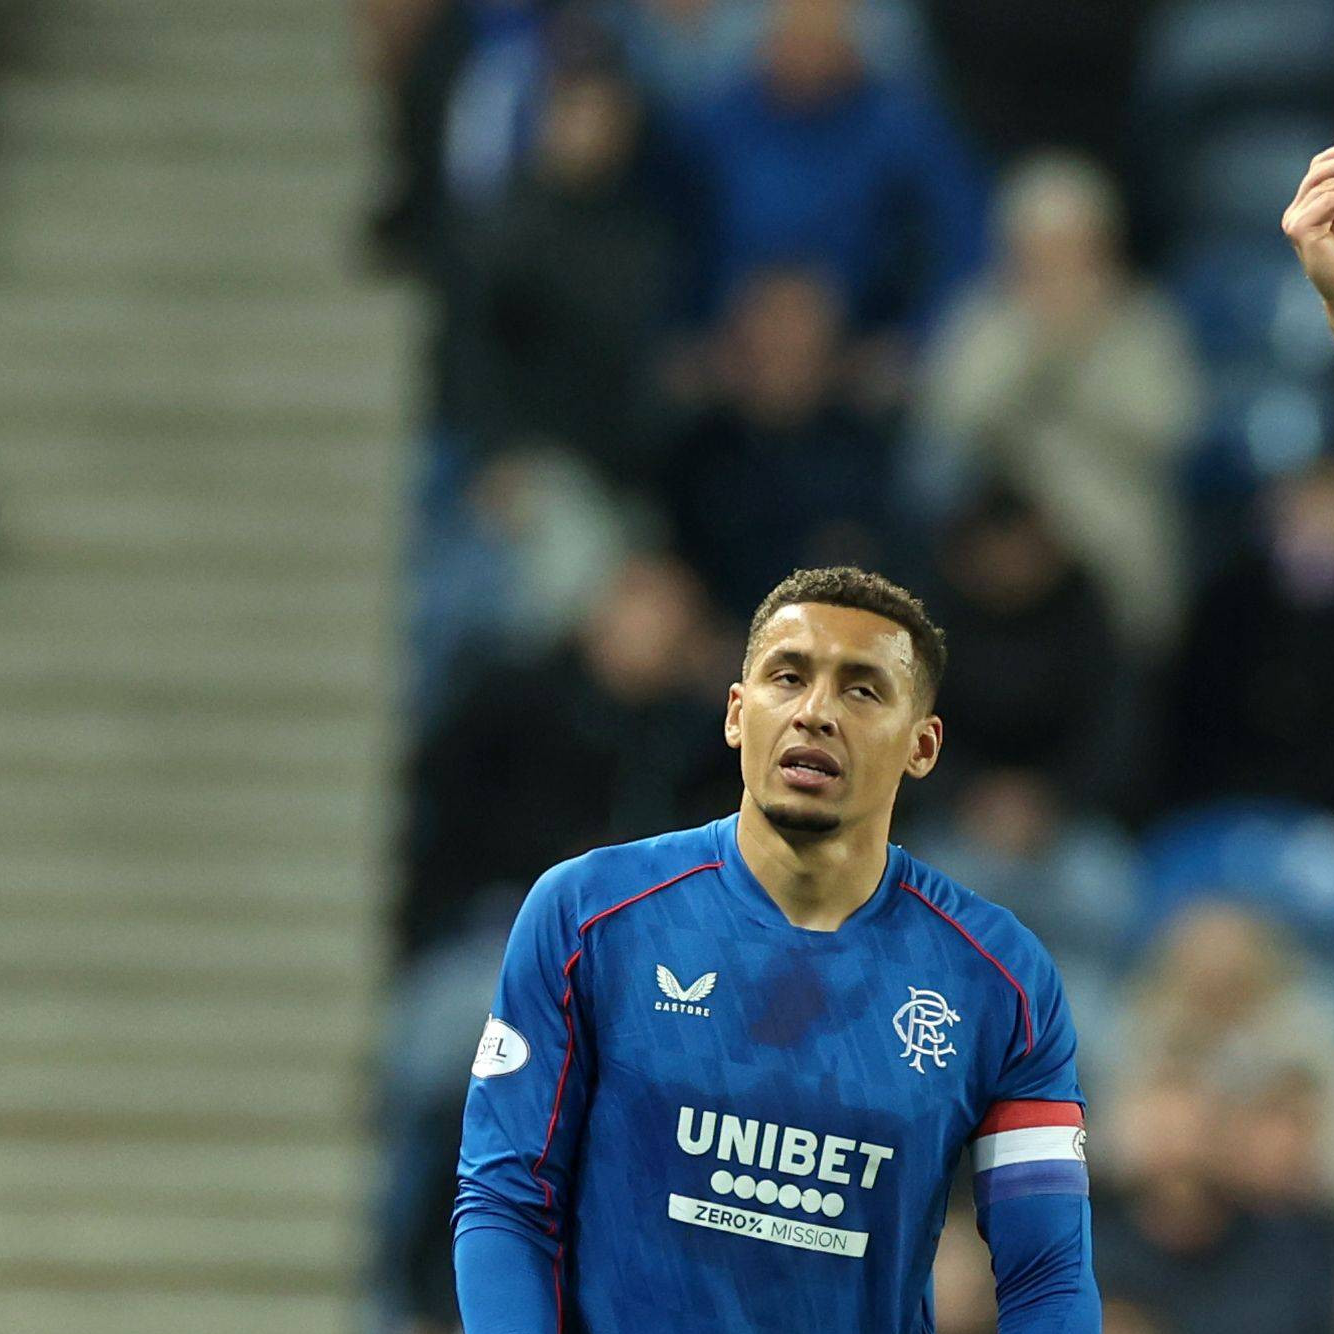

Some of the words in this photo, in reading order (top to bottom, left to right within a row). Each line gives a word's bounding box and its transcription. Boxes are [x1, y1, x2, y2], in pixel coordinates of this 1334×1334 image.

[654, 1001, 711, 1017] CASTORE
[676, 1106, 895, 1190] UNIBET
[694, 1205, 763, 1233] ZERO%
[770, 1221, 848, 1251] MISSION
